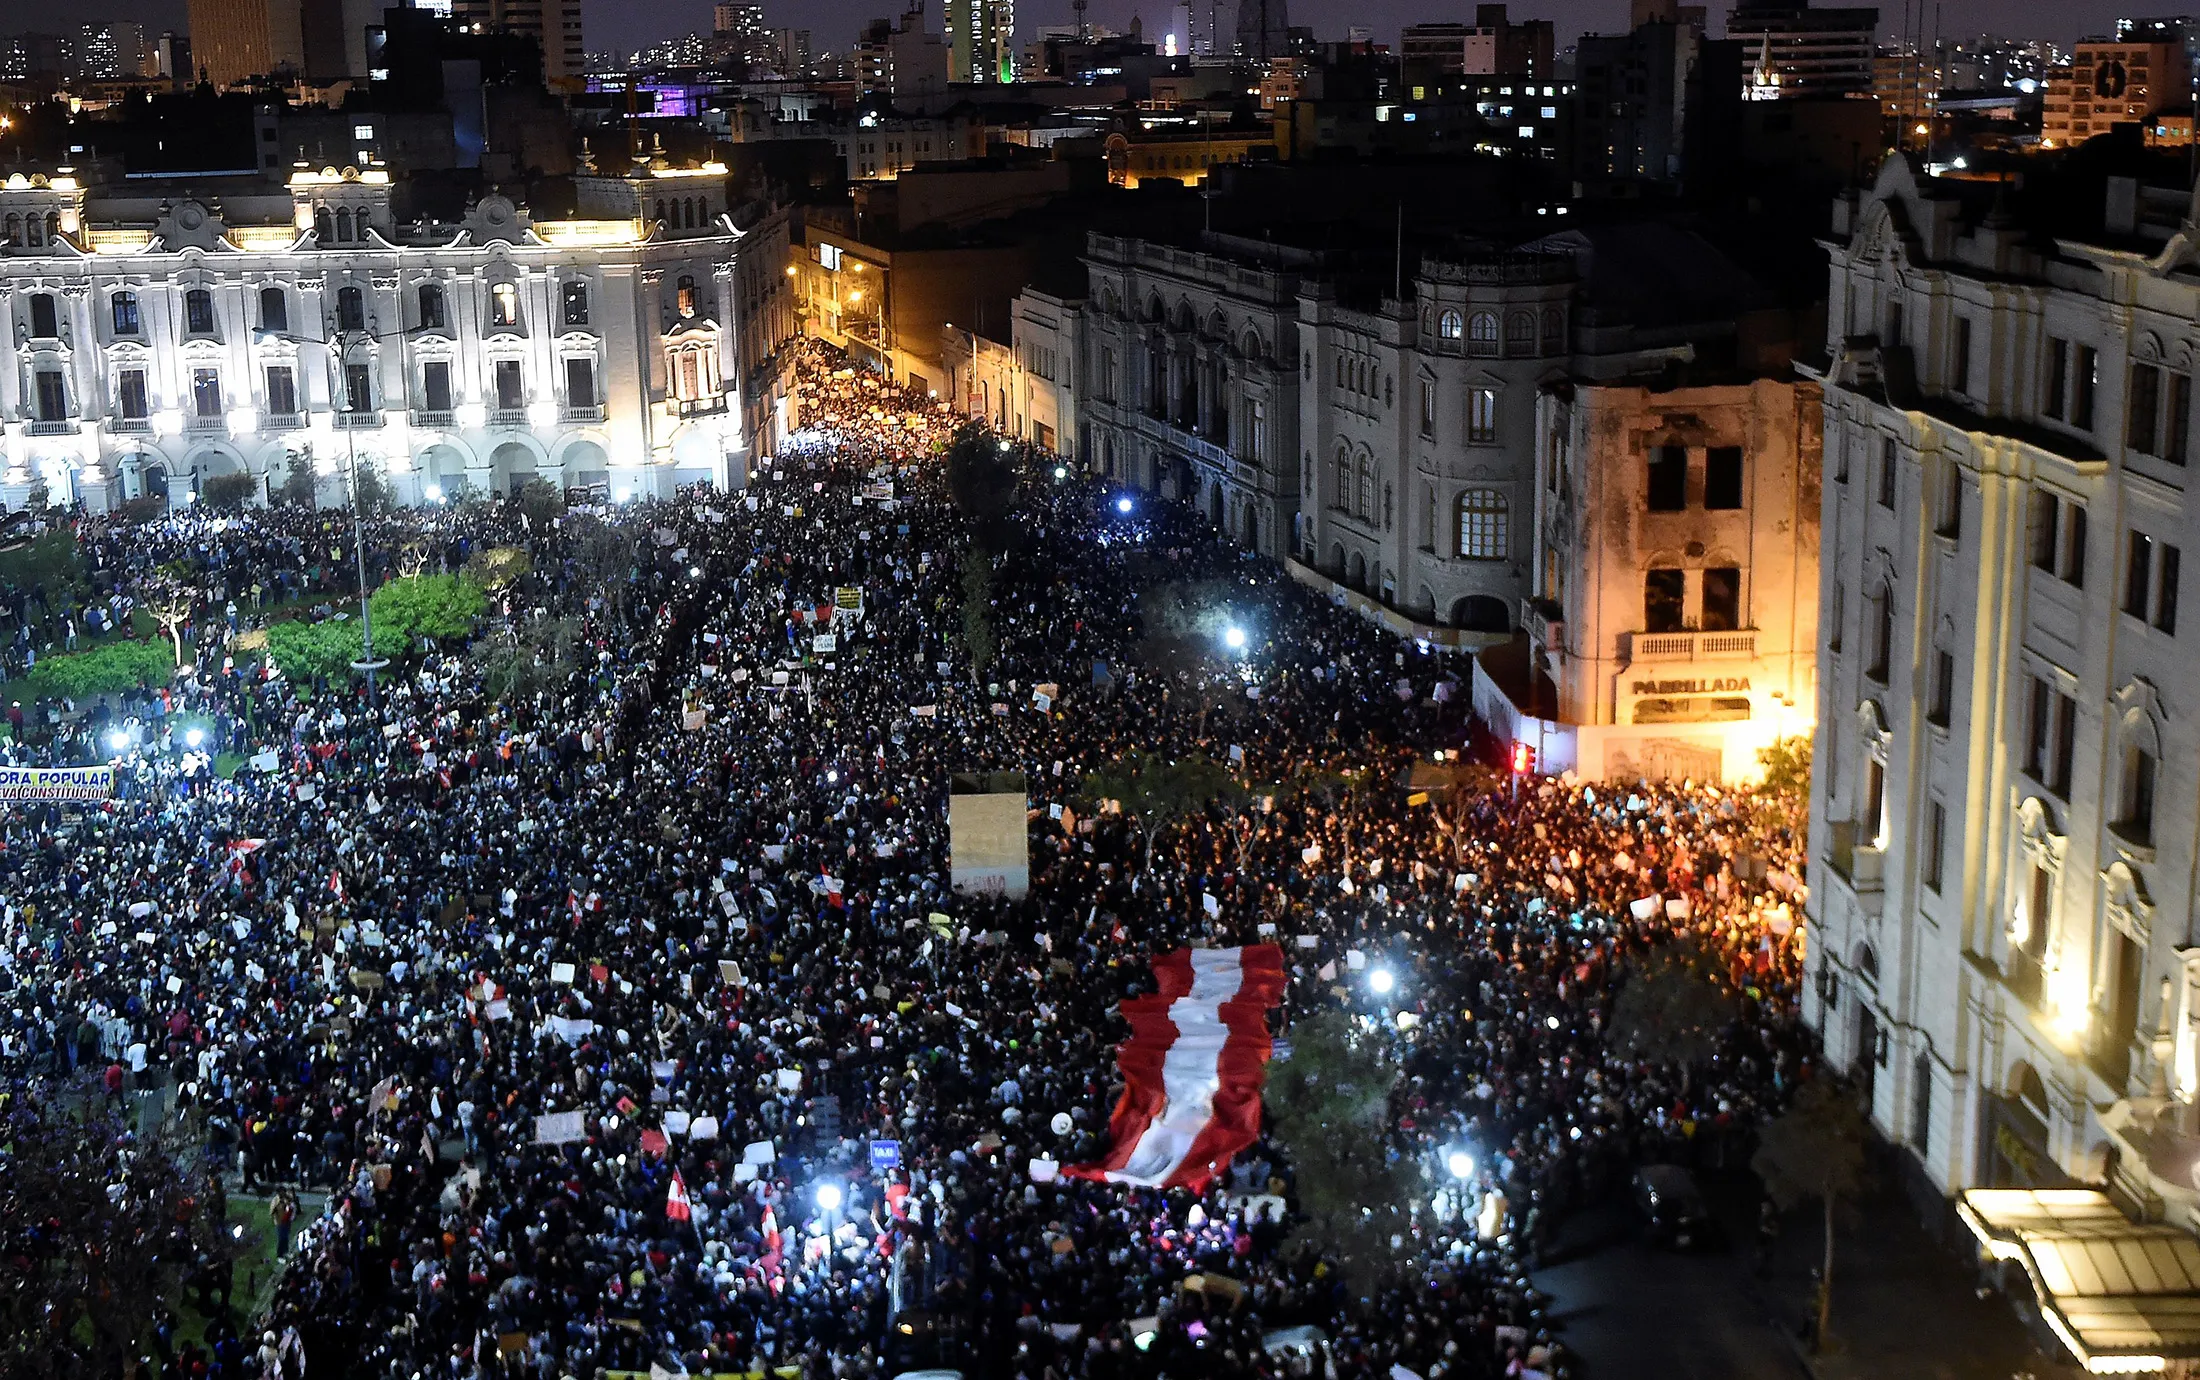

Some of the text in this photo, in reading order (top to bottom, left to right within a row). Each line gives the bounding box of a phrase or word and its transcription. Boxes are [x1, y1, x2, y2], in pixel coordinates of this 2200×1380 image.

[1632, 677, 1751, 694] PARRILLADA
[38, 772, 110, 786] POPULAR
[0, 787, 17, 798] VA
[873, 1147, 894, 1157] TAXI
